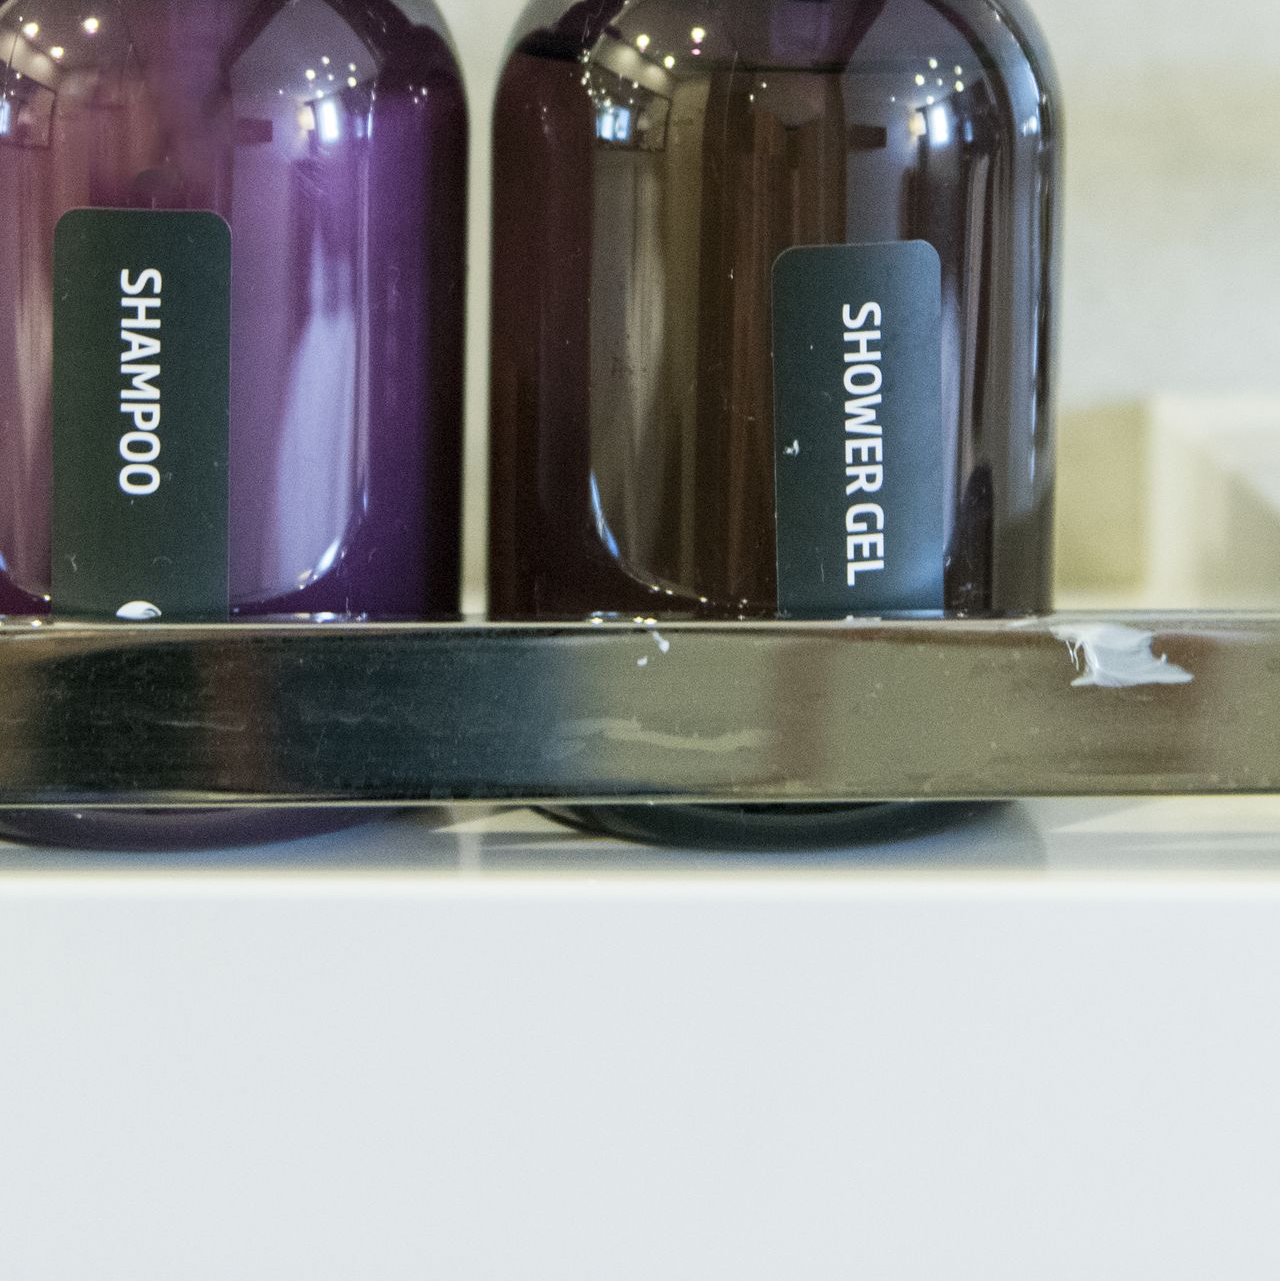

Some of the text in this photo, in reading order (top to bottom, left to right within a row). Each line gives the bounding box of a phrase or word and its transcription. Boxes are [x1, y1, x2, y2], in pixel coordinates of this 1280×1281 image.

[118, 268, 162, 495] SHAMPOO
[842, 301, 885, 586] SHOWER GEL
